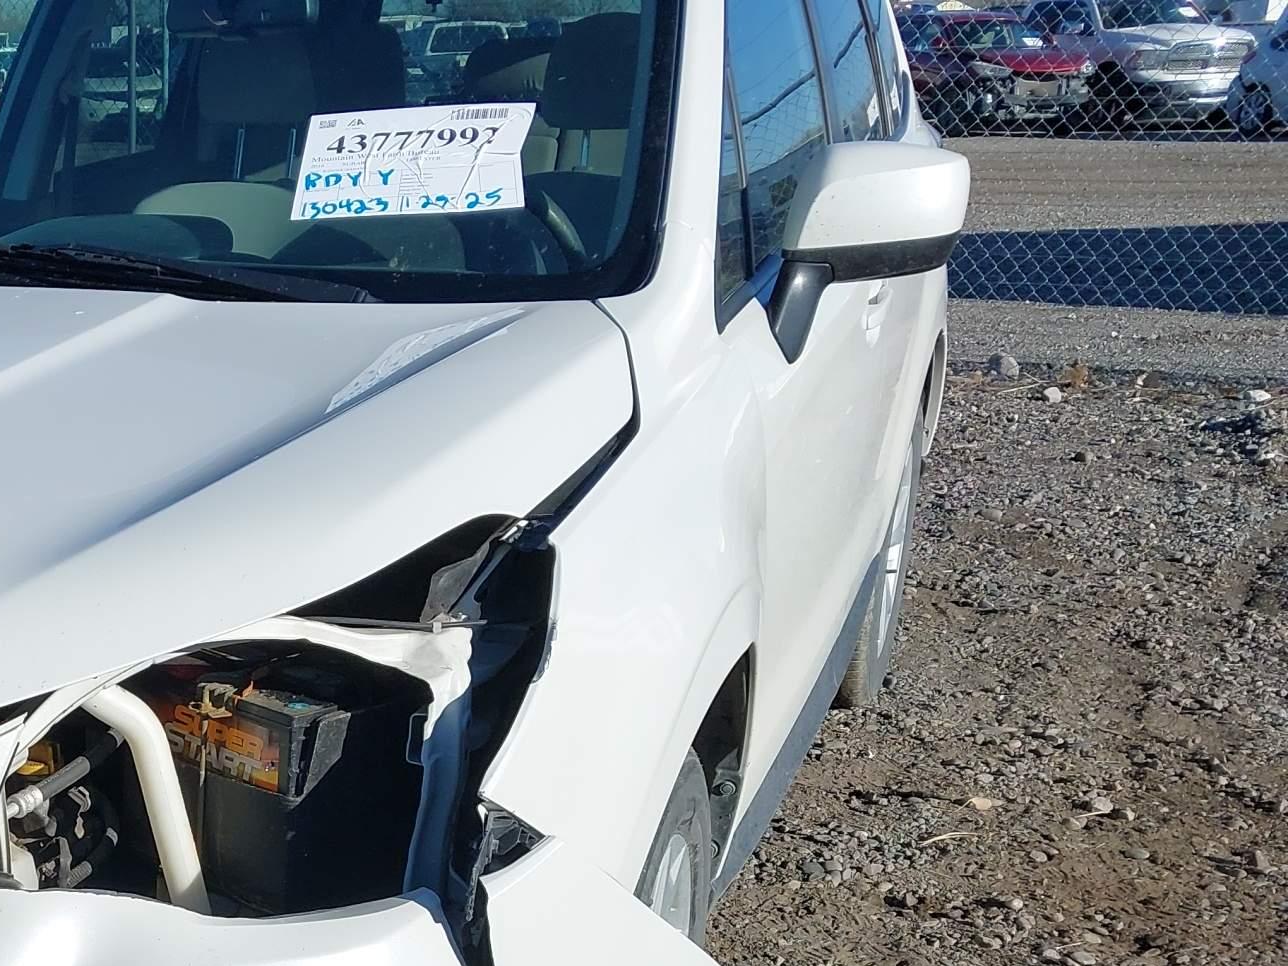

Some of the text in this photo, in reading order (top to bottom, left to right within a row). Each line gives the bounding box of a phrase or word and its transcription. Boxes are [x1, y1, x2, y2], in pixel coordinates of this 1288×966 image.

[326, 126, 500, 154] 43777992
[311, 153, 354, 163] Mountain
[304, 171, 362, 191] RDY
[174, 704, 264, 761] SUPER
[165, 721, 263, 781] START
